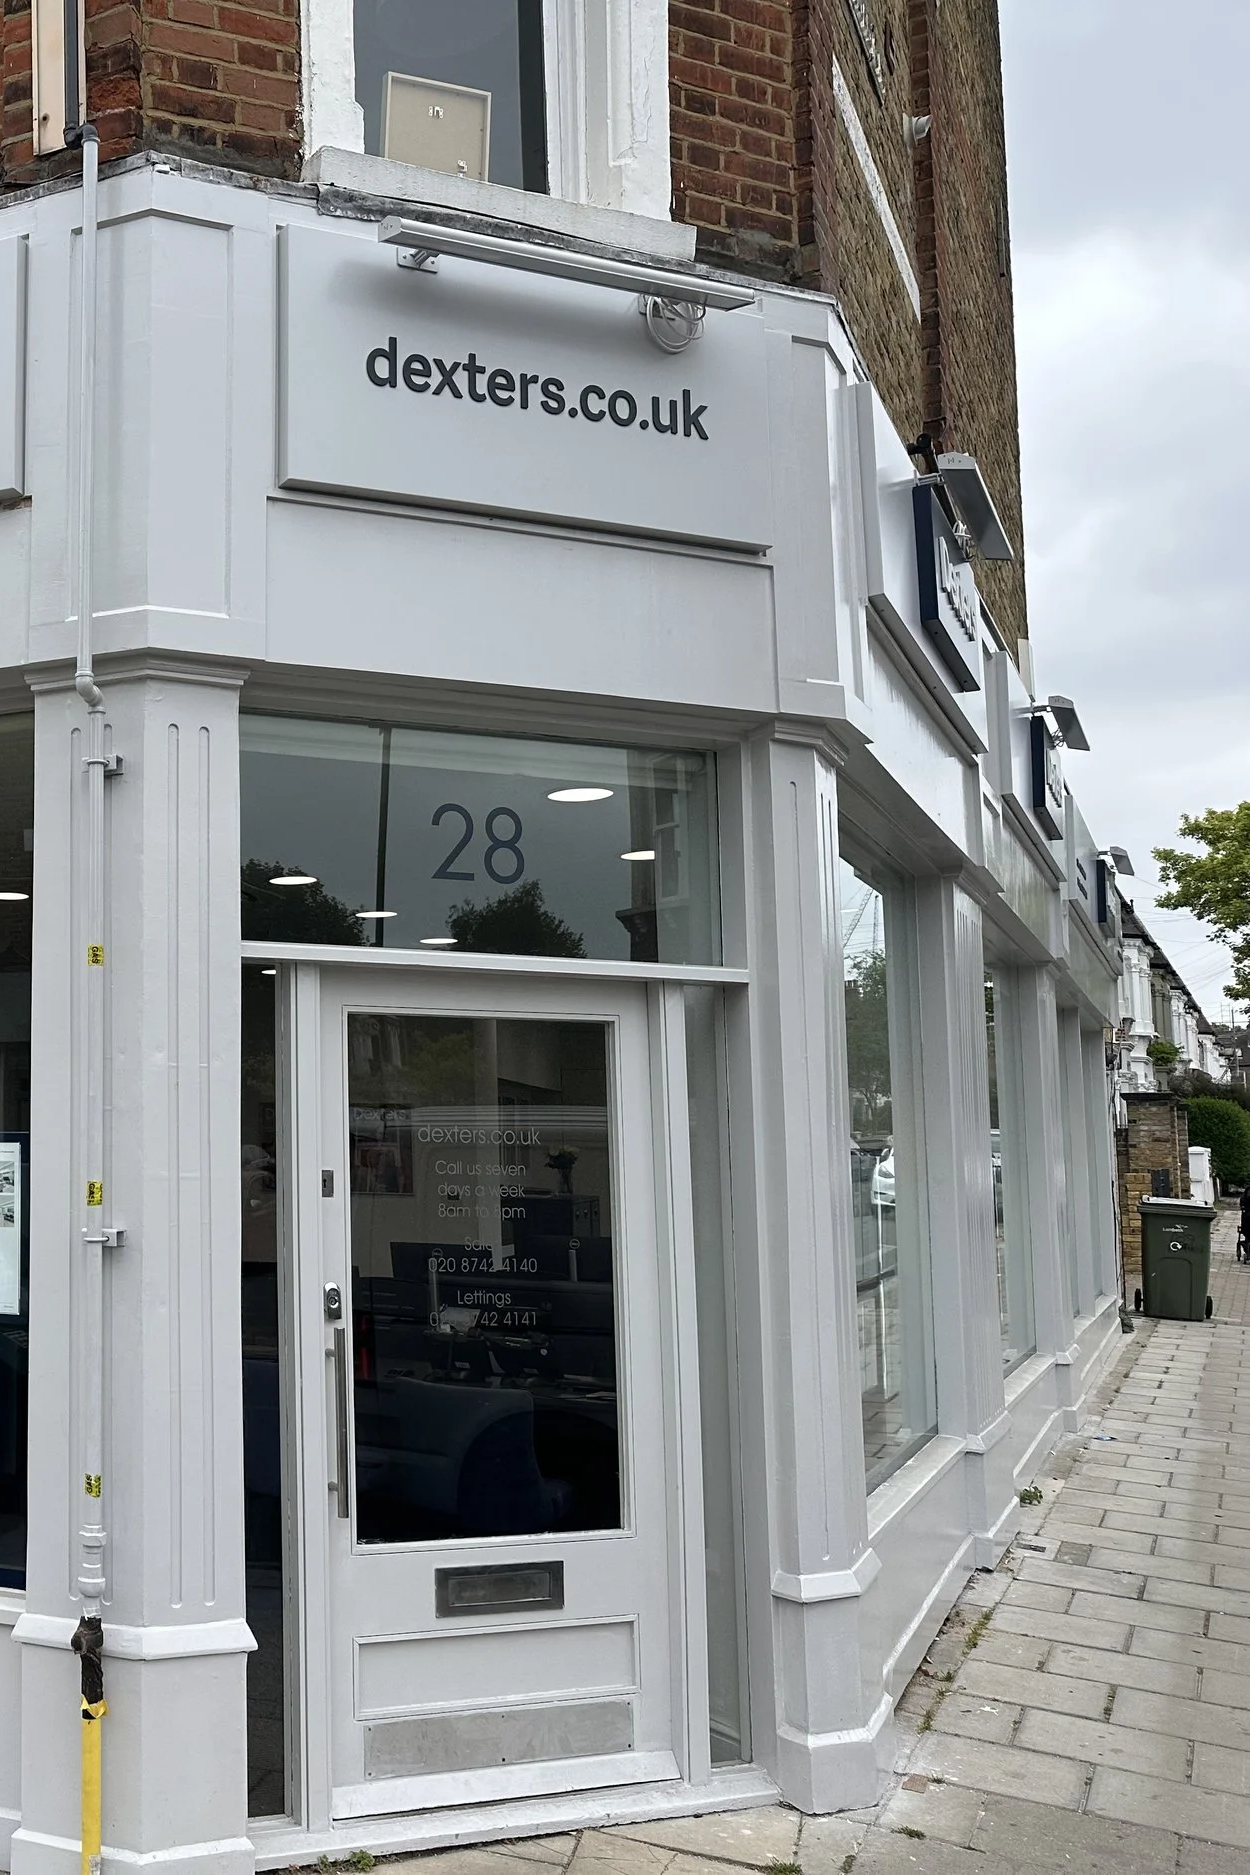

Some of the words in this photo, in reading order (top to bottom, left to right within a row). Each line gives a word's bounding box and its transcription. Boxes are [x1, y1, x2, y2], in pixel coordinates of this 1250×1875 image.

[366, 336, 709, 440] dexters.co.uk
[431, 802, 525, 885] 28
[91, 946, 99, 964] GAS
[417, 1124, 541, 1145] dexters.co.uk
[435, 1160, 462, 1175] Call
[467, 1163, 481, 1175] us
[485, 1163, 526, 1176] seven
[438, 1182, 470, 1198] days
[475, 1186, 484, 1196] a
[438, 1203, 470, 1218] 8am
[464, 1236, 496, 1251] Sal
[428, 1258, 456, 1273] 020
[461, 1258, 497, 1273] 8742
[501, 1258, 538, 1273] 4140
[457, 1290, 511, 1308] Lettings
[464, 1312, 498, 1326] 742
[504, 1312, 537, 1326] 4141
